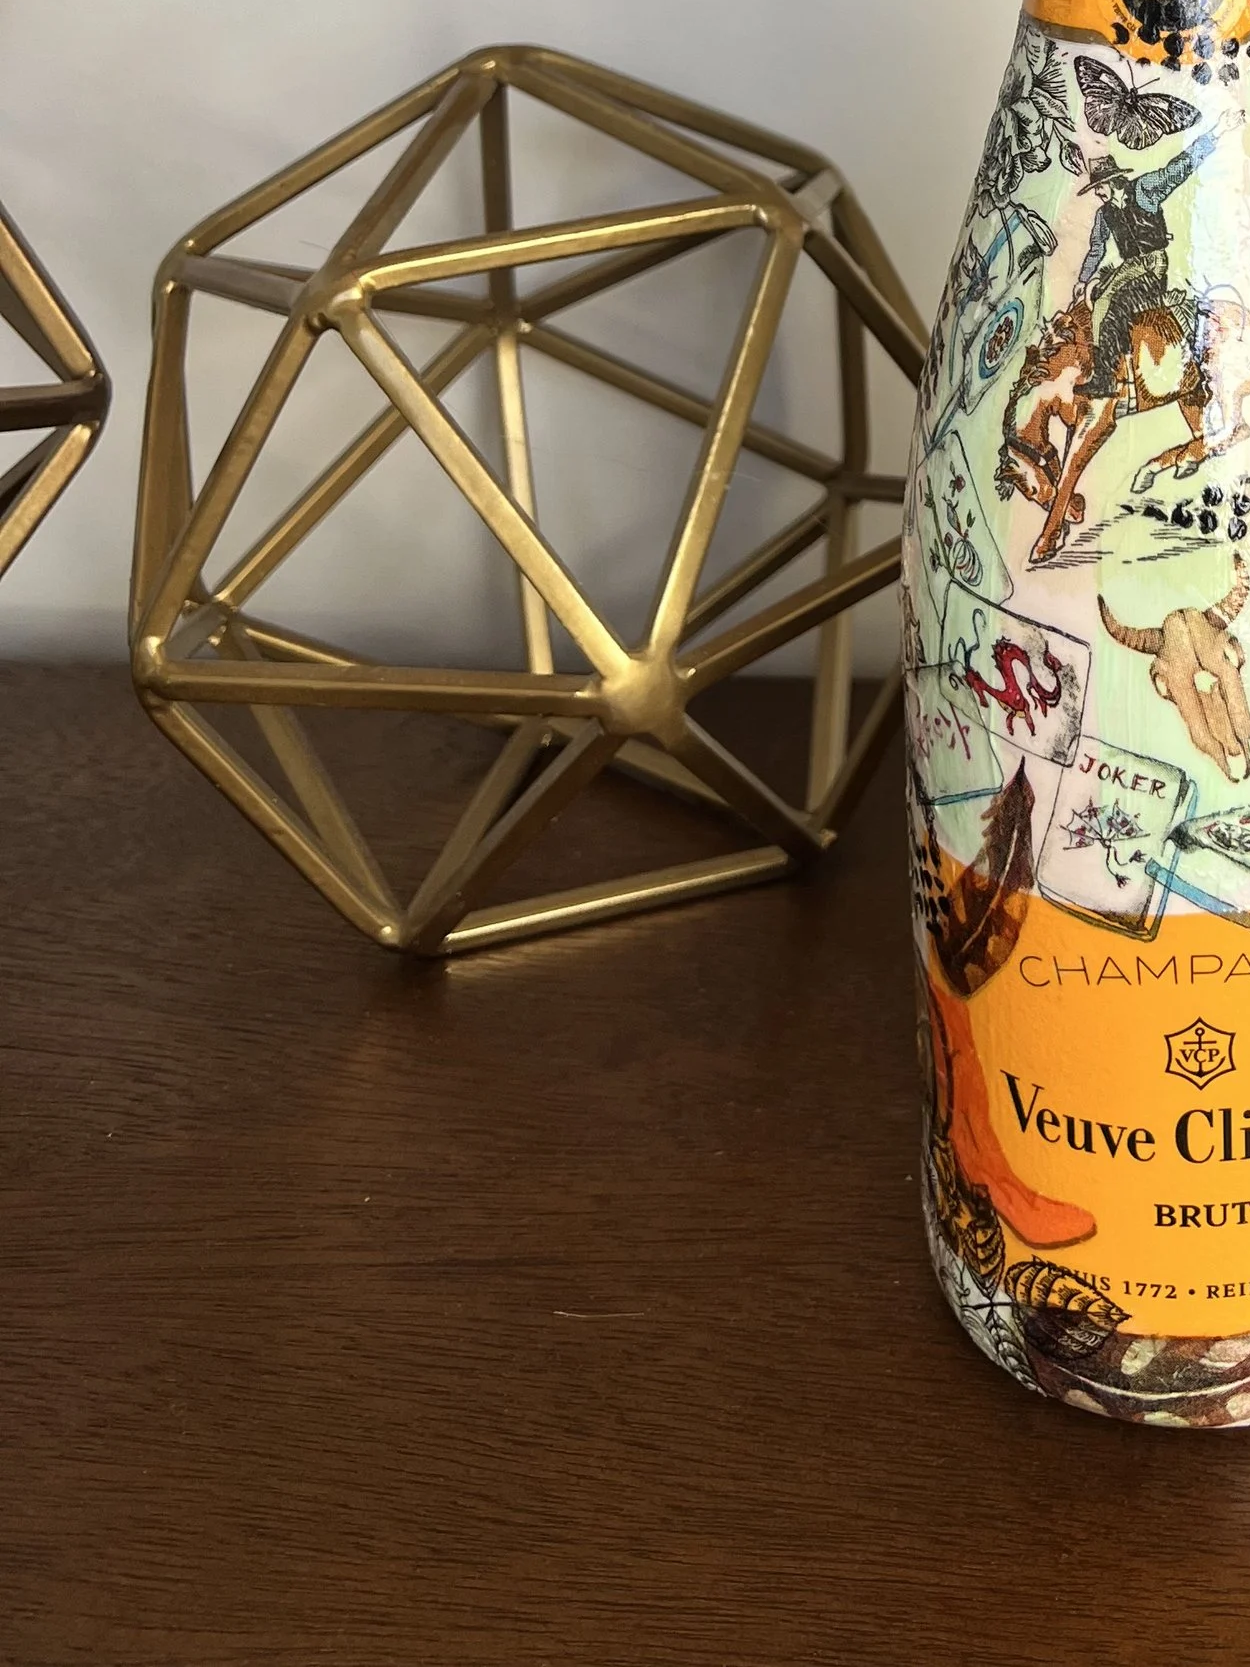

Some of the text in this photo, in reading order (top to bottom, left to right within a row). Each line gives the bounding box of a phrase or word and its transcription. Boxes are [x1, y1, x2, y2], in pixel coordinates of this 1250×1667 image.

[1078, 754, 1167, 800] JOKER
[1179, 1047, 1220, 1063] VCP
[1000, 1069, 1156, 1163] Veuve
[1122, 1280, 1178, 1300] 1772
